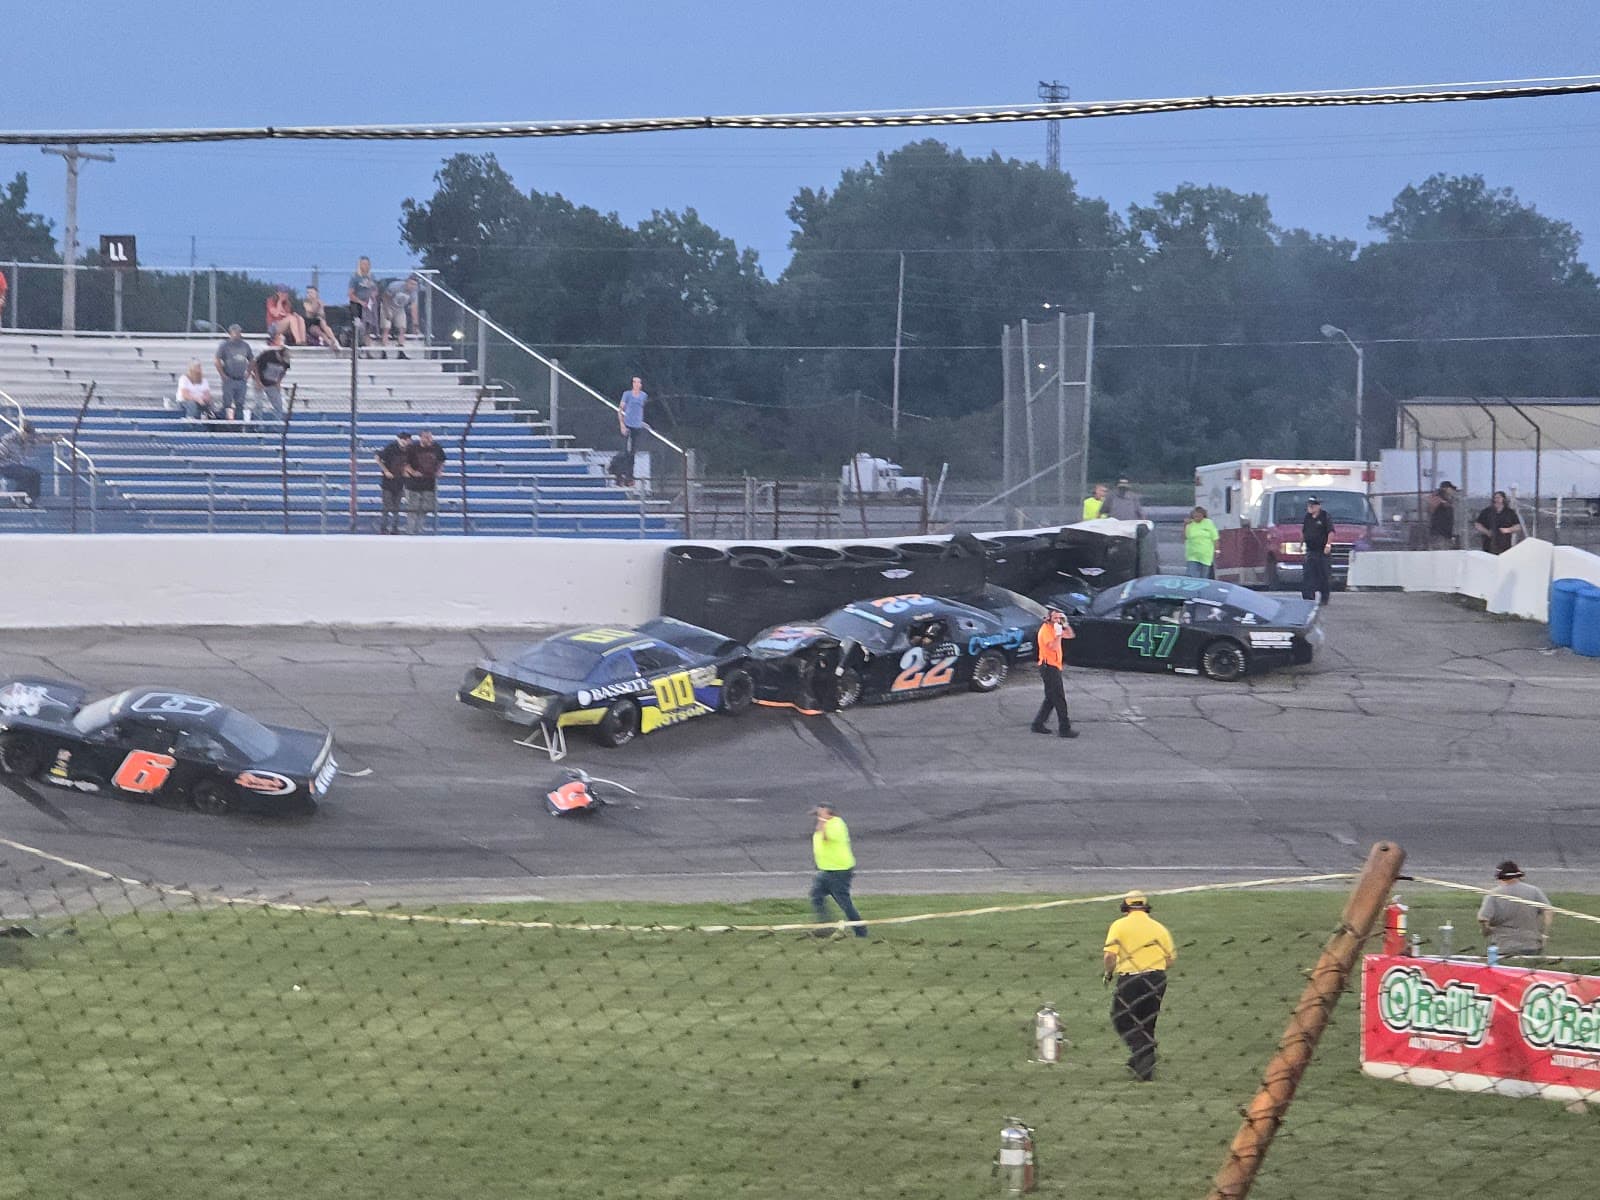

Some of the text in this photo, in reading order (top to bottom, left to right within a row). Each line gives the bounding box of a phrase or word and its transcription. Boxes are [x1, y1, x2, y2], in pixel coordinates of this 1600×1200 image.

[1127, 622, 1180, 658] 47
[589, 677, 649, 701] BASSETT
[891, 643, 961, 692] 22
[651, 671, 696, 713] 00
[111, 749, 177, 794] 6
[1383, 970, 1492, 1042] O'Reilly
